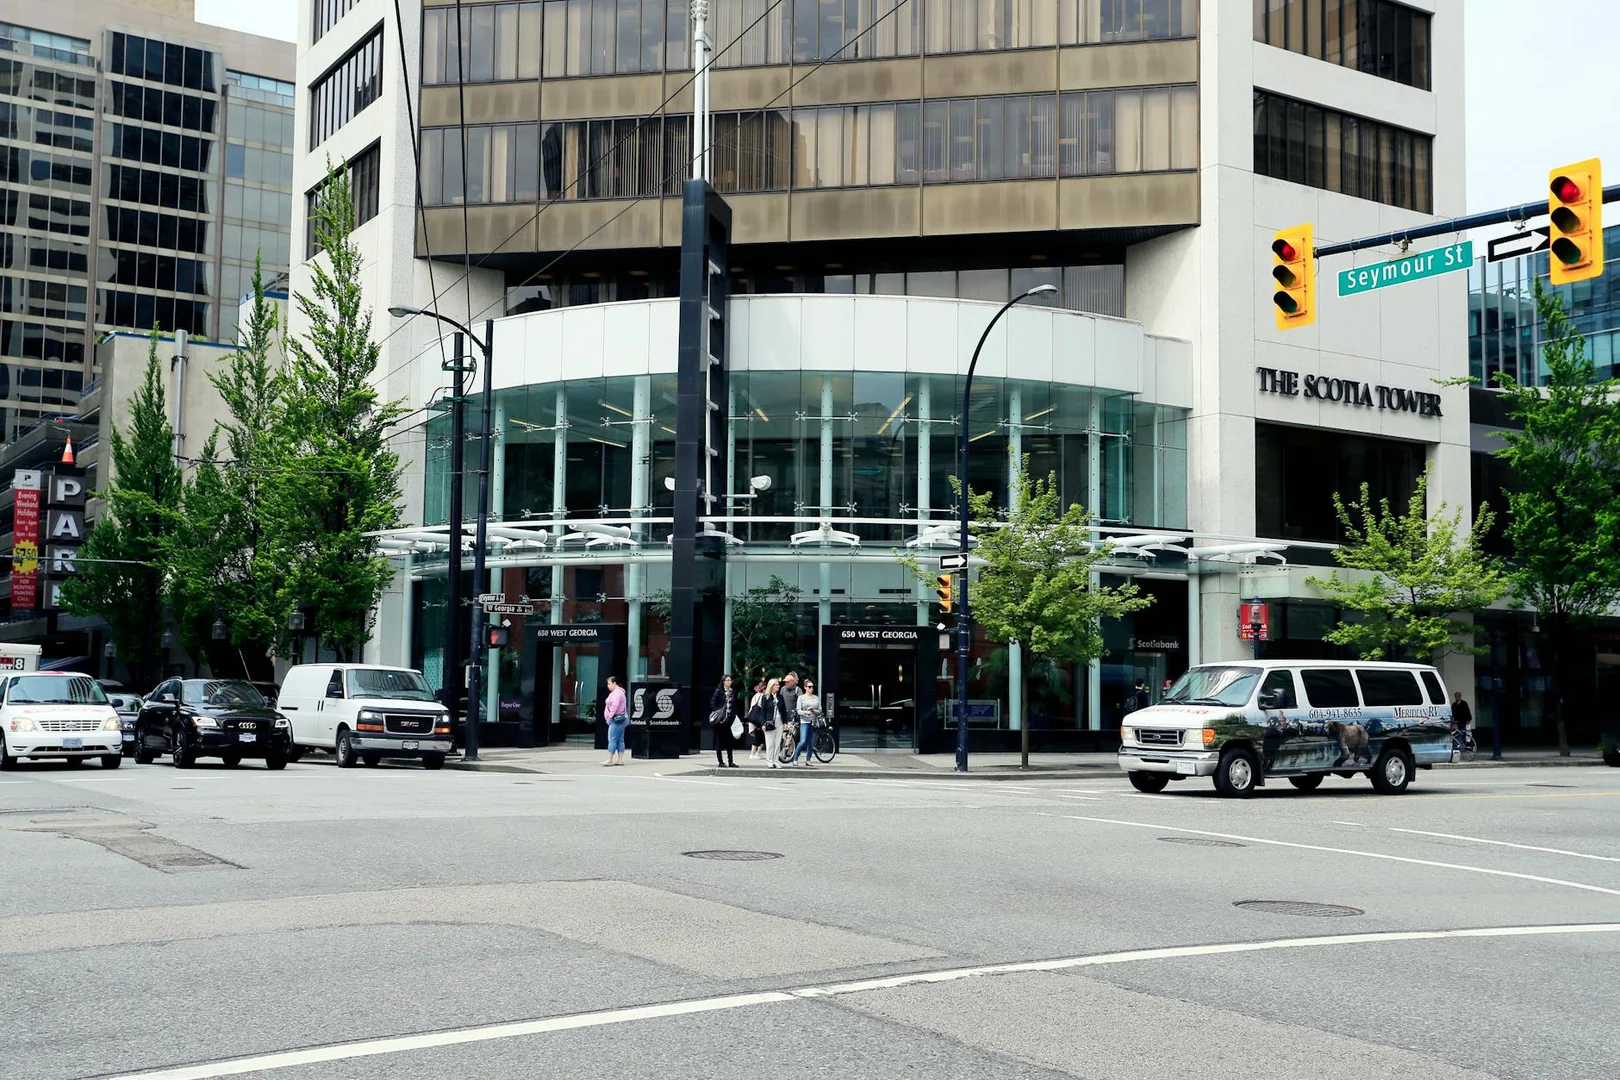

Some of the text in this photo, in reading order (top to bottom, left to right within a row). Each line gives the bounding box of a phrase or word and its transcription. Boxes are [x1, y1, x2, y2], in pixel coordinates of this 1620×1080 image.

[1347, 244, 1463, 288] Seymour St
[1256, 366, 1444, 417] THE SCOTIA TOWER
[18, 491, 37, 501] Evening
[16, 509, 37, 518] Holidays
[494, 605, 515, 613] Georgia
[537, 629, 598, 637] 650 WEST GEORGIA
[841, 630, 918, 639] 650 WEST GEORGIA
[1137, 639, 1180, 649] Scotiabank
[15, 658, 24, 670] 8
[1308, 708, 1363, 719] 604-941-8635
